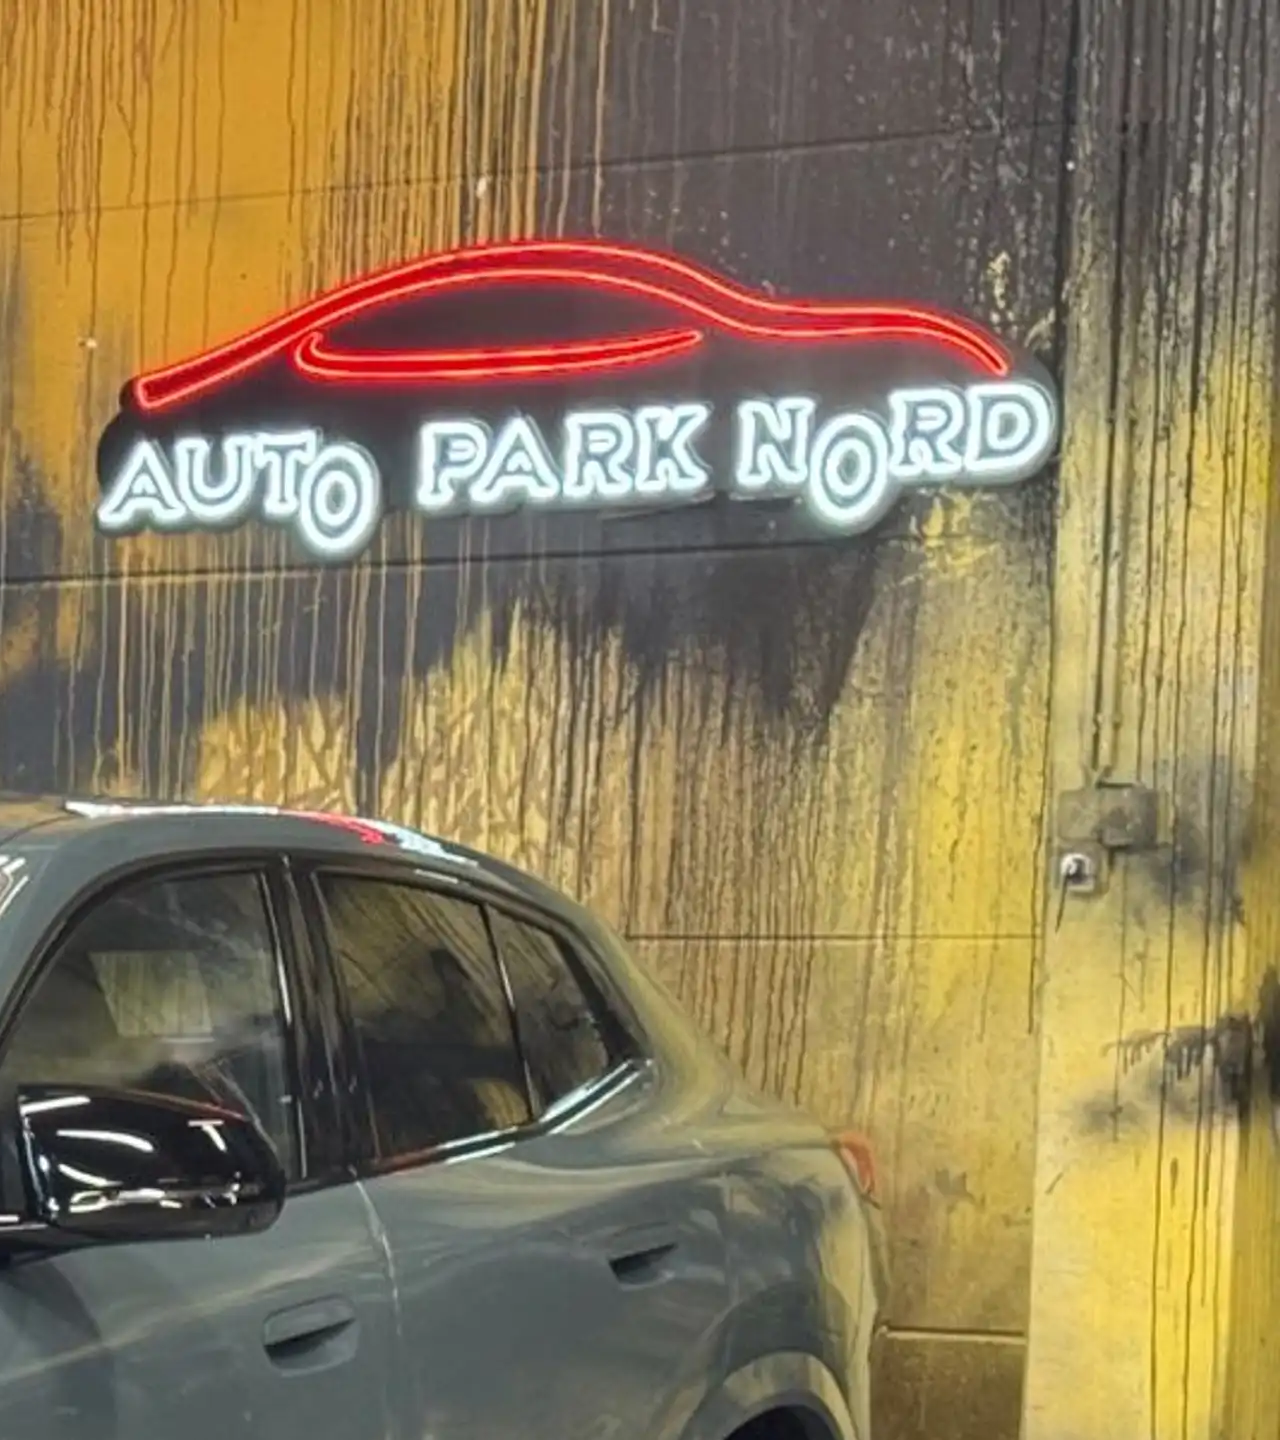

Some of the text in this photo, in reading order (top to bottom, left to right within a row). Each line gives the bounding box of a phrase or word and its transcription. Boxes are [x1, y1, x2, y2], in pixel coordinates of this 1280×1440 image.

[96, 382, 1054, 555] AUTO PARK NORD
